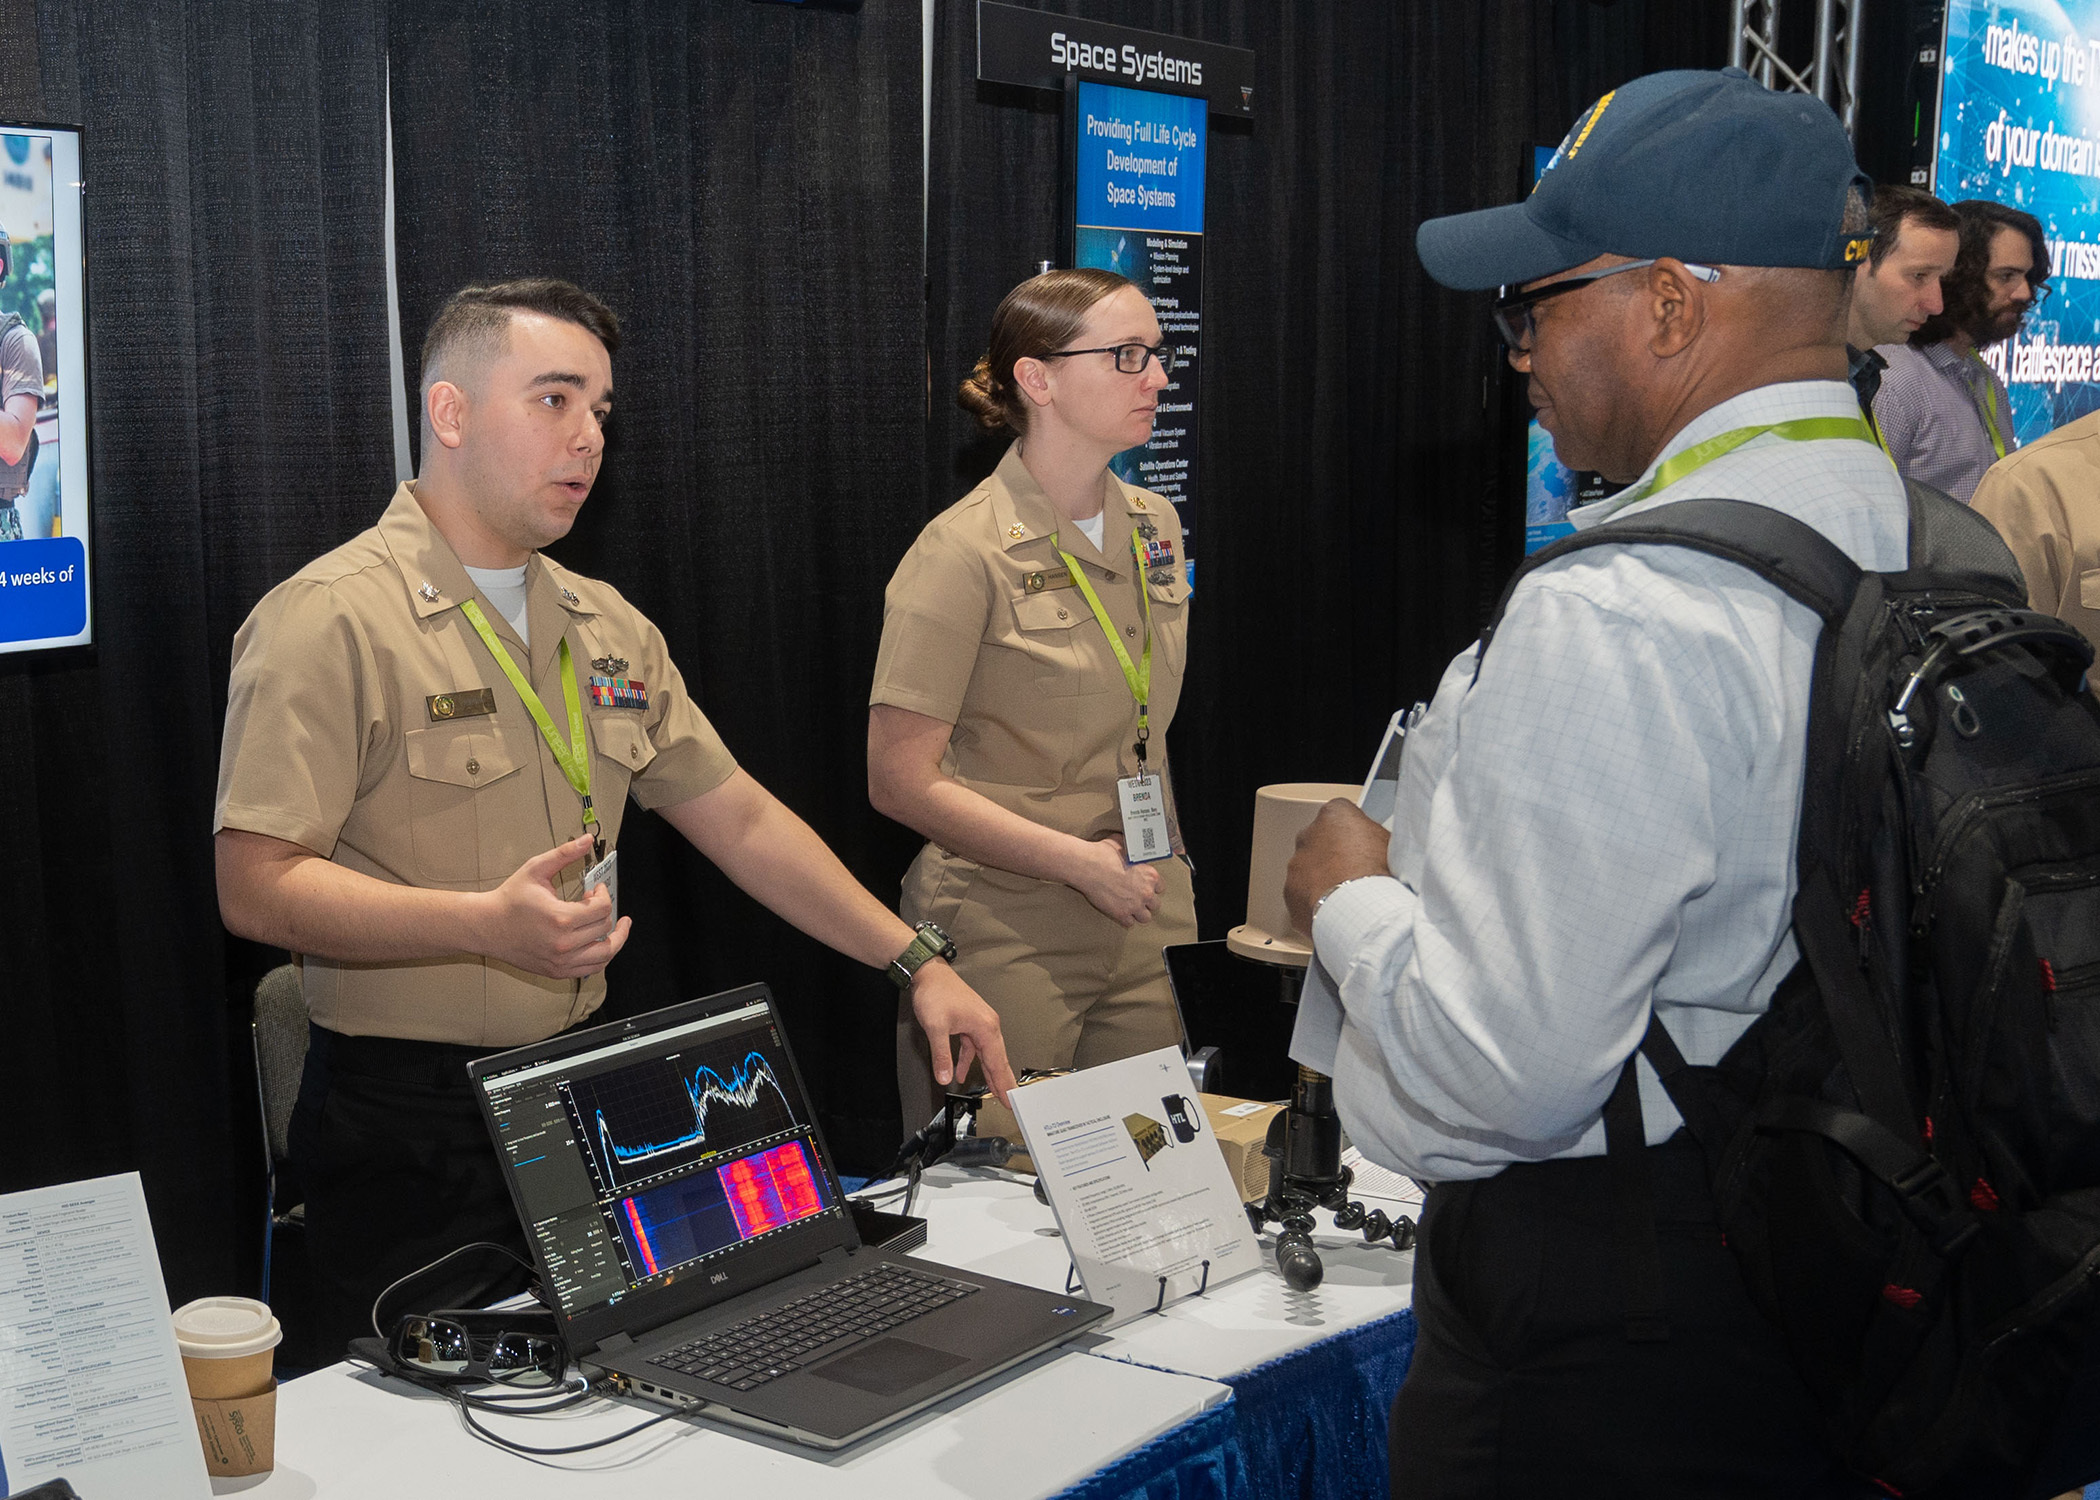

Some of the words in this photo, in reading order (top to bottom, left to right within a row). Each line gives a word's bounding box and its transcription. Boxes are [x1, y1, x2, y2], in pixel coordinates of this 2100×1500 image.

[1051, 32, 1116, 71] Space
[1122, 45, 1202, 85] Systems
[1985, 18, 2039, 75] makes
[2040, 39, 2061, 92] up
[2062, 34, 2085, 86] the
[1087, 114, 1132, 146] Providing
[1134, 120, 1151, 142] Full
[1153, 123, 1170, 144] Life
[1172, 125, 1197, 151] Cycle
[1986, 109, 2007, 162] of
[2002, 125, 2041, 178] your
[2040, 120, 2092, 176] domain
[1107, 150, 1166, 178] Development
[1168, 157, 1178, 177] of
[1107, 182, 1136, 208] Space
[1137, 186, 1176, 210] Systems
[2012, 333, 2092, 394] battlespace
[10, 566, 55, 586] weeks
[59, 564, 74, 582] of
[1170, 1112, 1187, 1125] HTL
[710, 1272, 729, 1285] DELL
